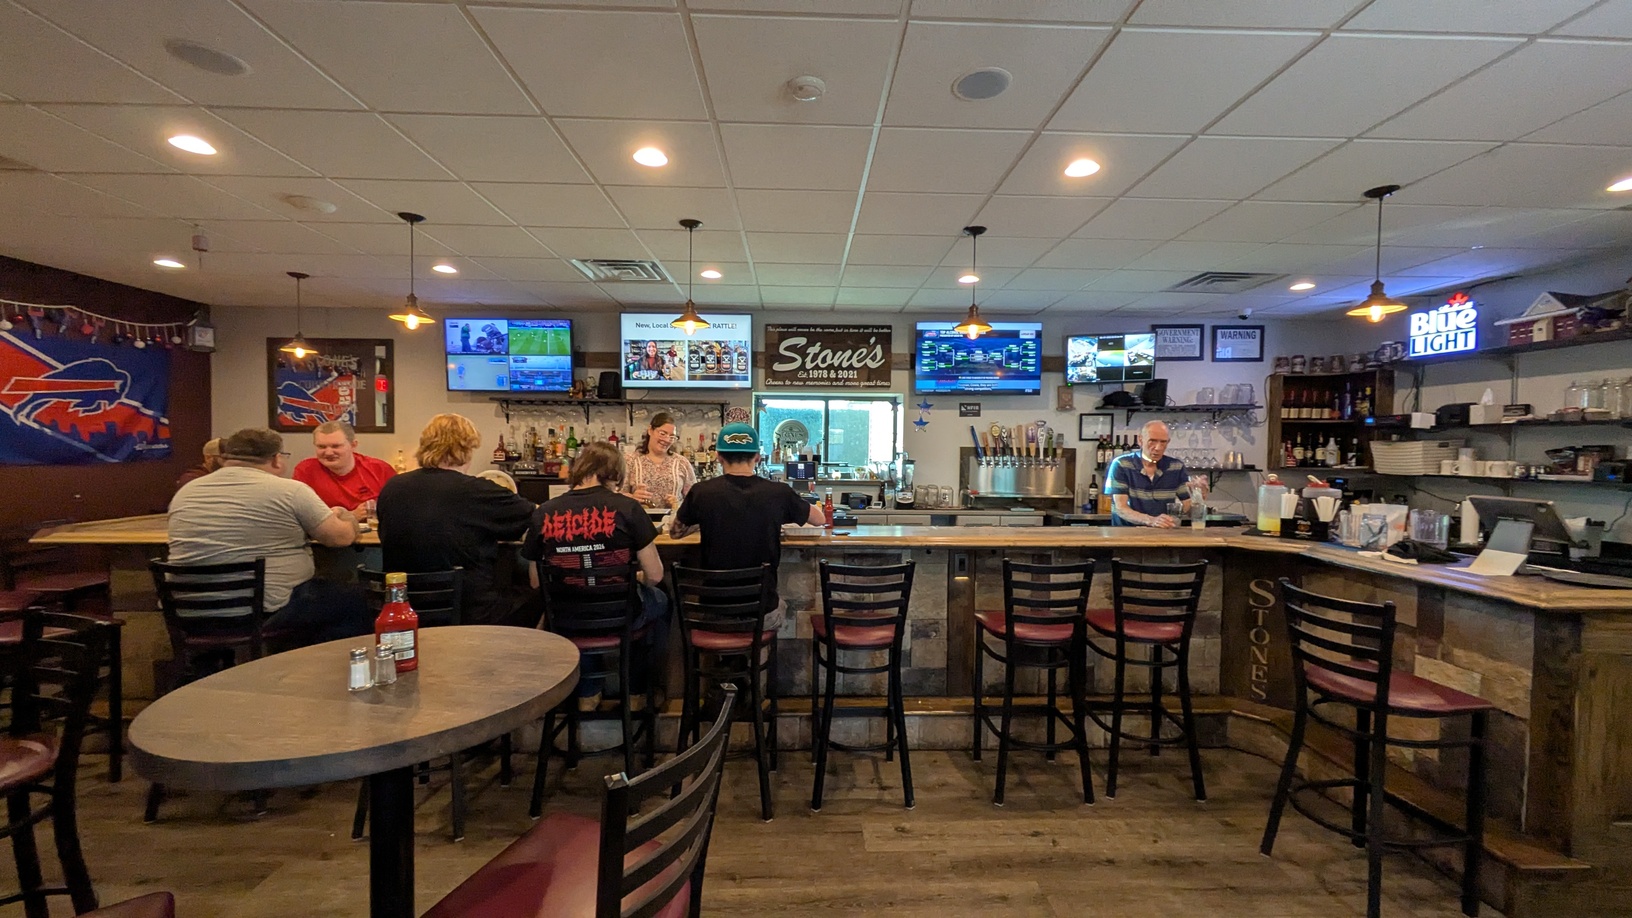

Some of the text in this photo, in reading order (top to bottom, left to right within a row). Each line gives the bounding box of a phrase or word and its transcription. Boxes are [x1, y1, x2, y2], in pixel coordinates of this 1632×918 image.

[1410, 308, 1477, 336] Blue
[1220, 330, 1257, 340] WARNING
[1411, 329, 1474, 354] LIGHT
[772, 336, 885, 371] Stone's
[809, 369, 828, 378] 1978
[829, 369, 836, 378] &
[837, 370, 858, 379] 2021
[860, 380, 876, 388] great
[541, 505, 617, 543] DEICIDE
[572, 544, 593, 553] AMERICA
[1248, 578, 1276, 700] STONES
